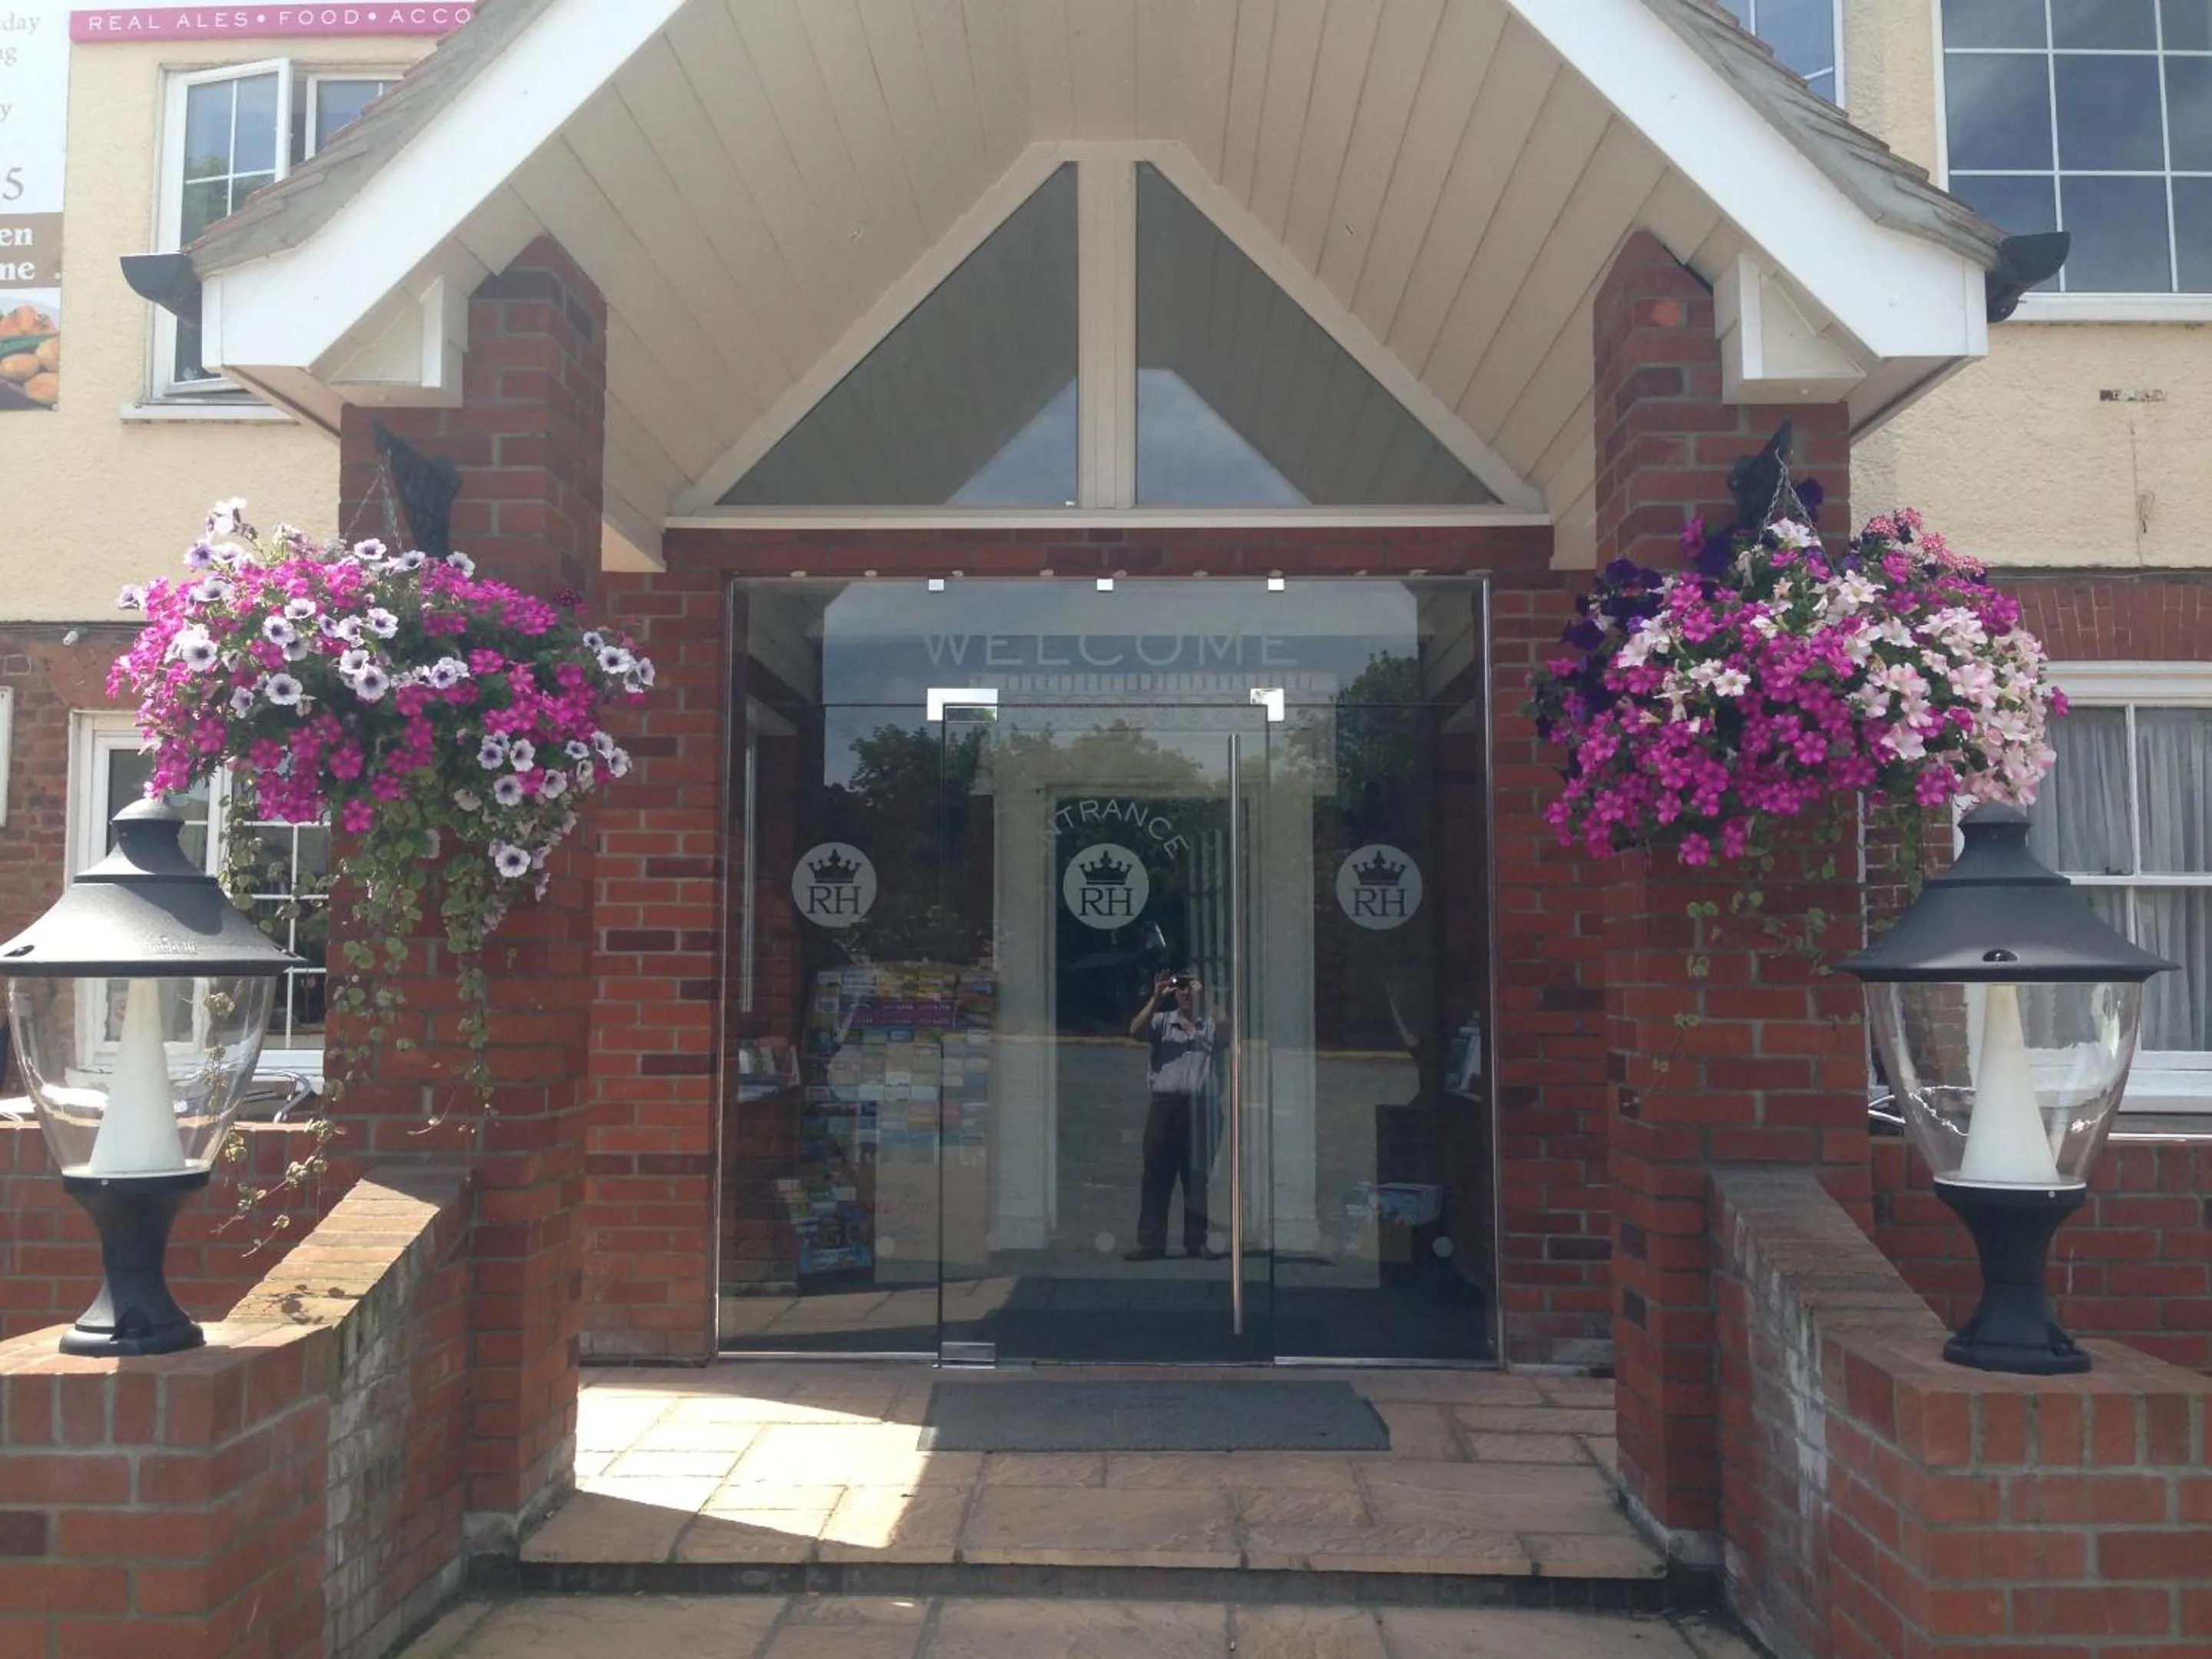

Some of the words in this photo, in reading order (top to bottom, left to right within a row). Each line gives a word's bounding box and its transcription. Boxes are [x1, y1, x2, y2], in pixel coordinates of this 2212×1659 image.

[88, 15, 160, 31] REAL
[176, 12, 248, 28] ALES
[279, 9, 359, 25] FOOD
[924, 634, 1299, 666] WELCOME
[806, 885, 862, 915] RH
[1079, 887, 1134, 917] RH
[1352, 887, 1407, 917] RH
